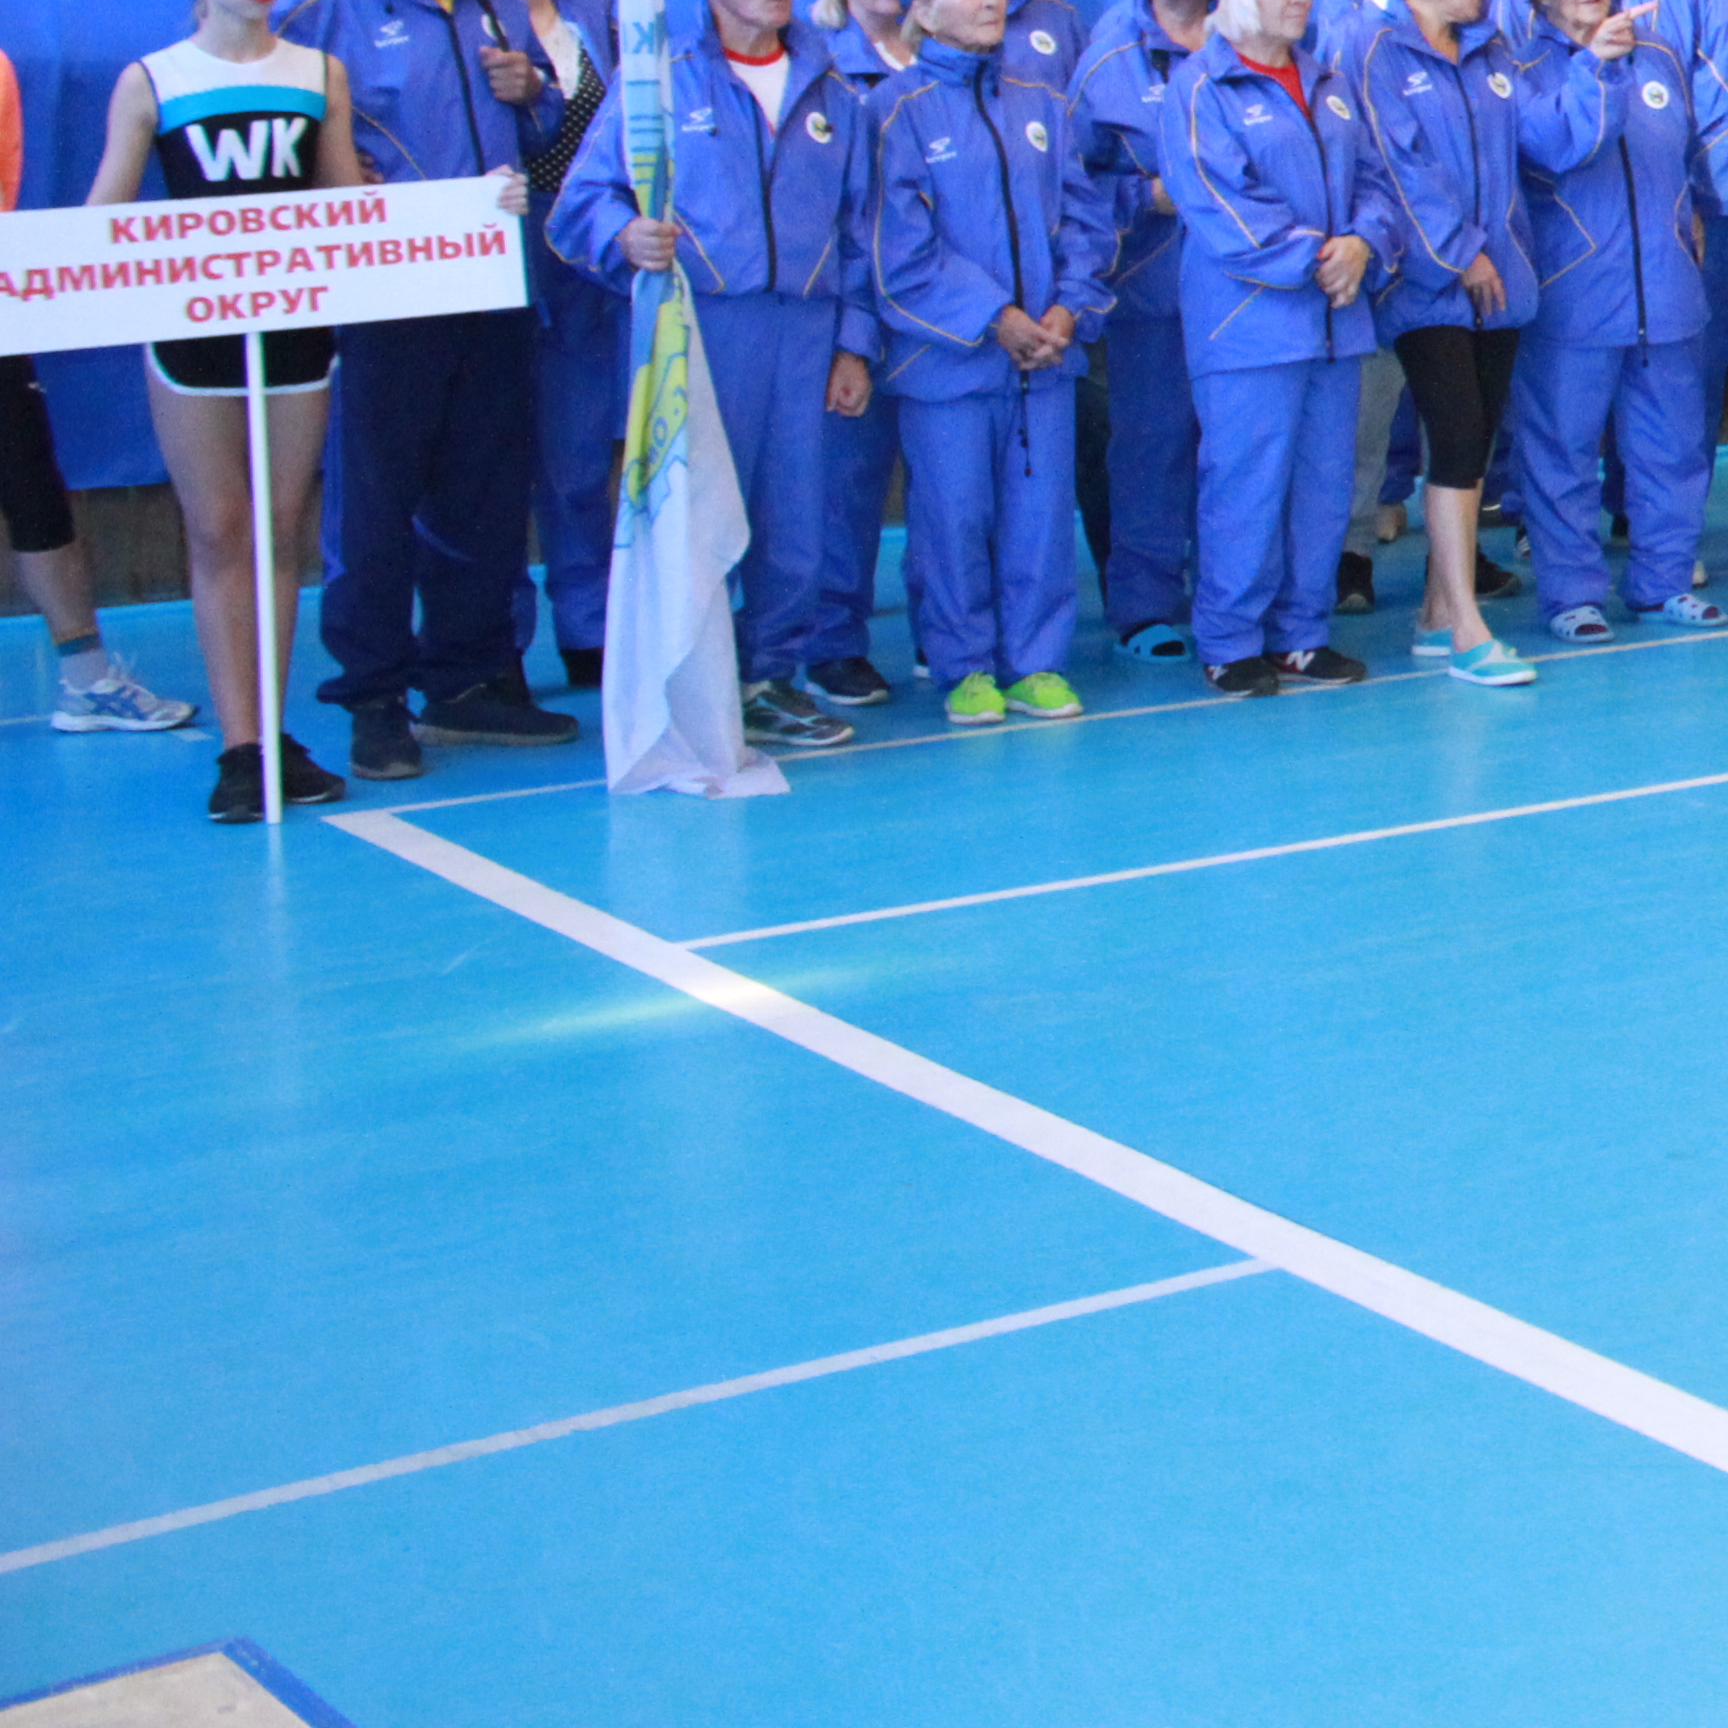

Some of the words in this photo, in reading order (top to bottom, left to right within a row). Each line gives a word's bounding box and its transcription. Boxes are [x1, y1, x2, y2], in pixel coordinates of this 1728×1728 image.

[185, 116, 308, 183] WK
[110, 190, 388, 245] КИРОВСКИЙ
[186, 285, 330, 324] ОКРУГ
